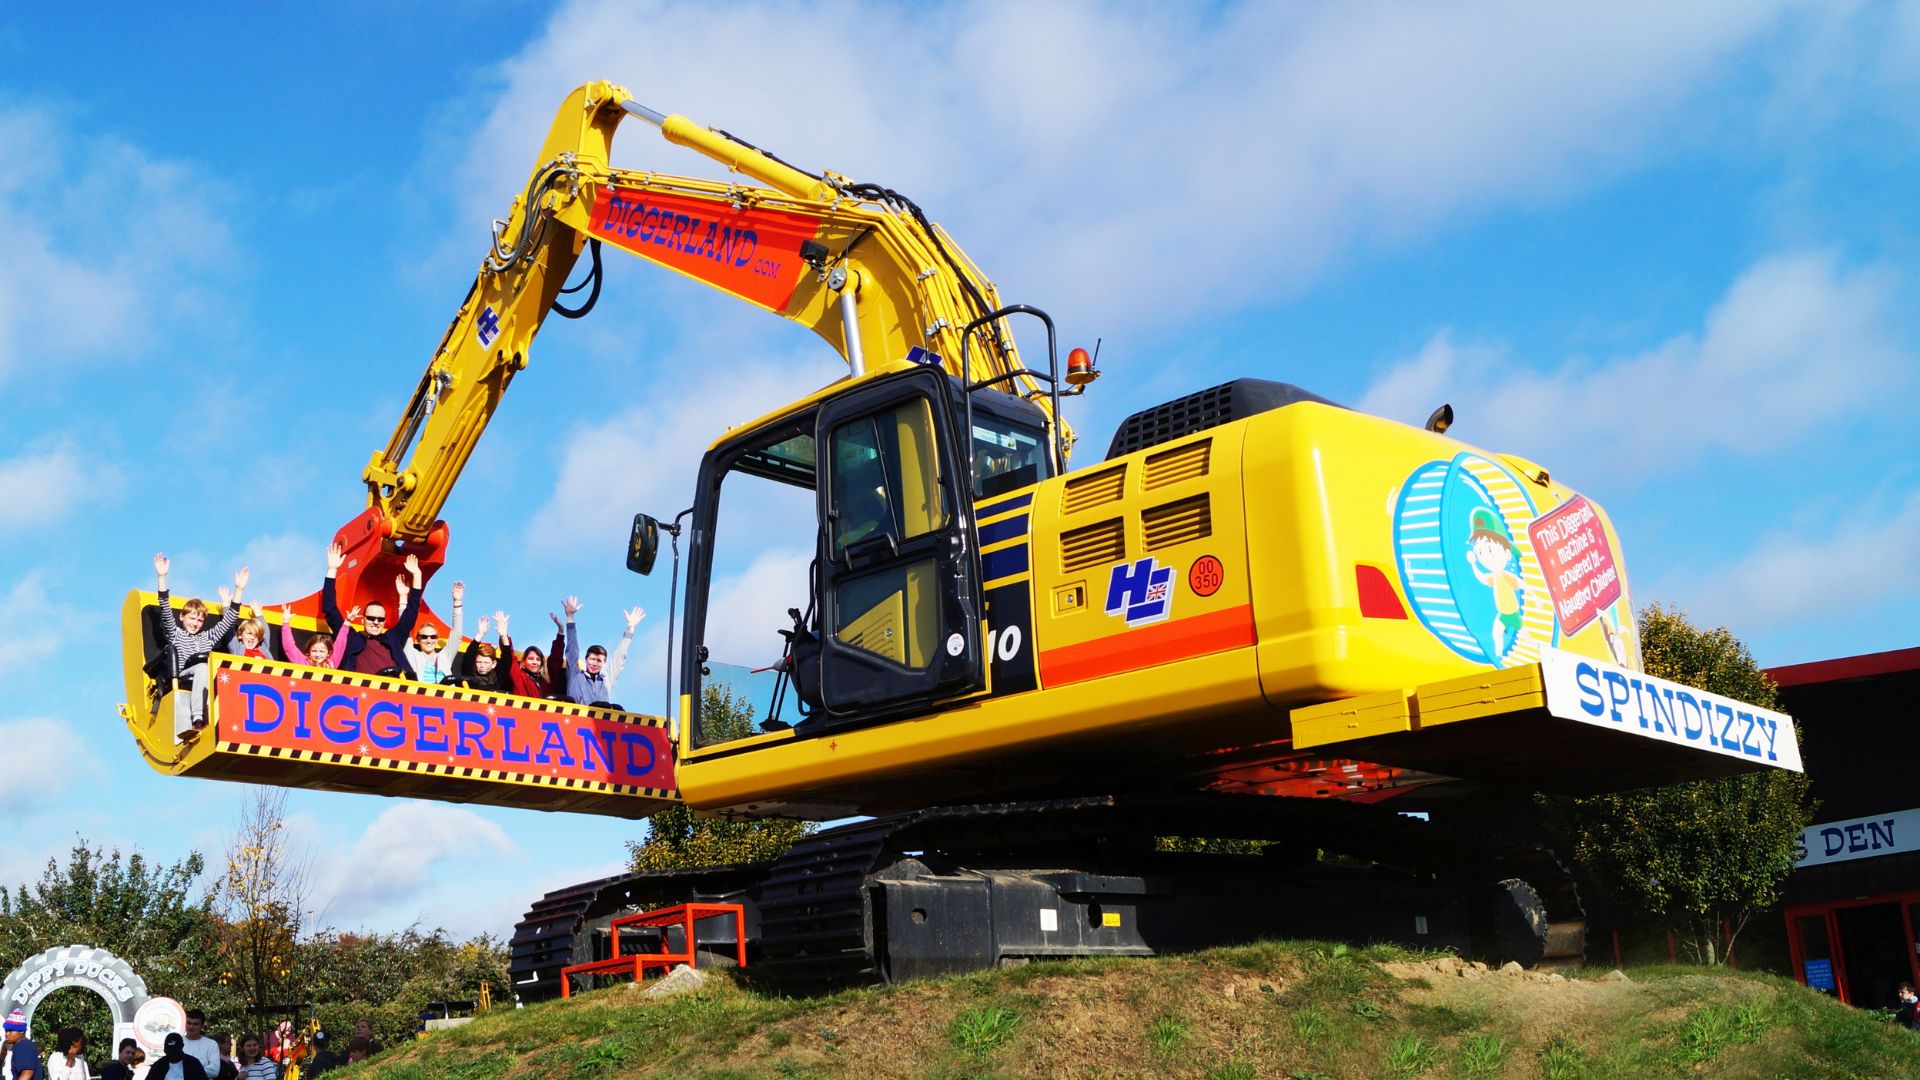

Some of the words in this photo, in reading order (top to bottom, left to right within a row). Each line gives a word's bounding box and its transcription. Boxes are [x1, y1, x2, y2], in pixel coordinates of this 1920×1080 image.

[604, 196, 758, 267] DIGGERLAND
[1537, 524, 1560, 550] This
[1557, 532, 1589, 565] machine
[1585, 527, 1596, 544] is
[1194, 573, 1219, 588] 350
[1199, 561, 1214, 574] 00
[1559, 553, 1593, 592] powered
[239, 683, 656, 777] DIGGERLAND
[1576, 662, 1777, 761] SPINDIZZY
[1820, 819, 1895, 857] DEN
[12, 960, 69, 1005] DIPPY
[73, 960, 134, 1002] DUCKS
